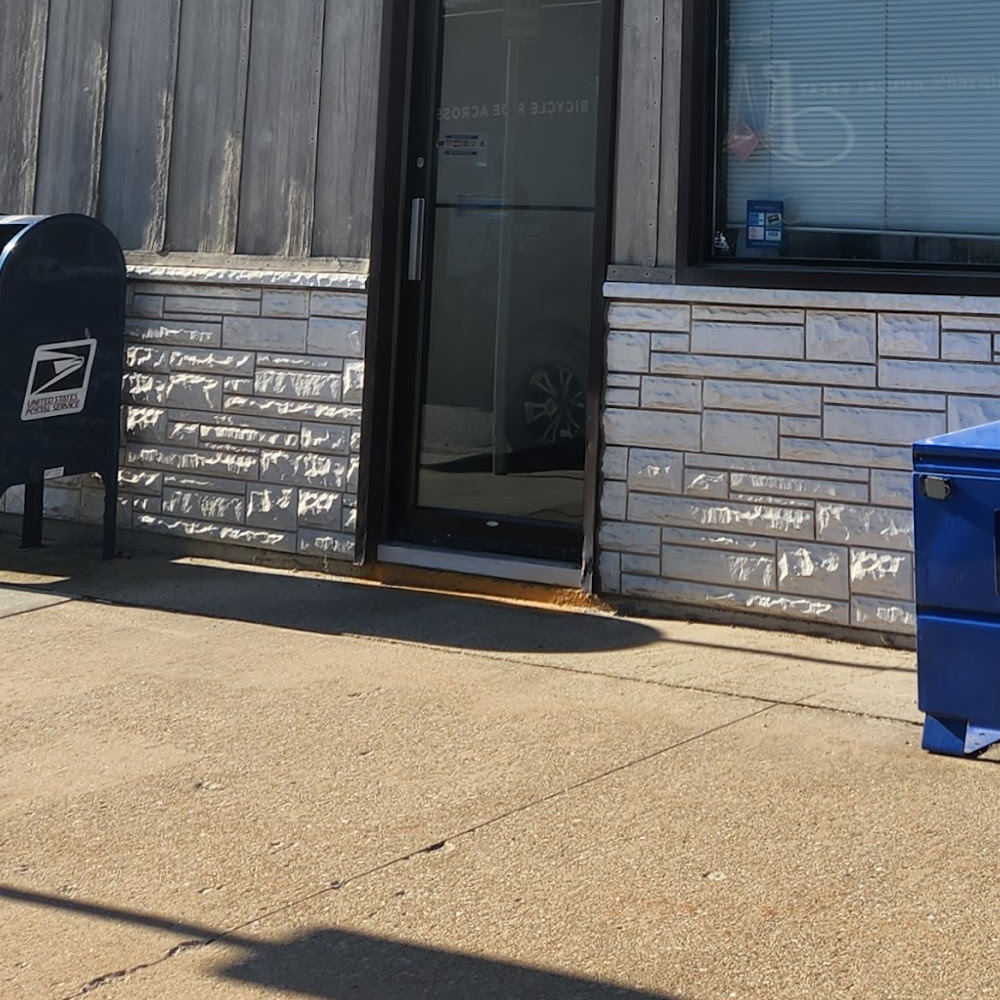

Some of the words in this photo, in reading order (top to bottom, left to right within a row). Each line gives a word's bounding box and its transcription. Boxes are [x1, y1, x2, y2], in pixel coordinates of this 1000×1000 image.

[25, 405, 51, 416] POSTAL
[52, 400, 80, 411] SERVICE
[28, 397, 54, 408] UNITED
[54, 393, 79, 402] STATES
